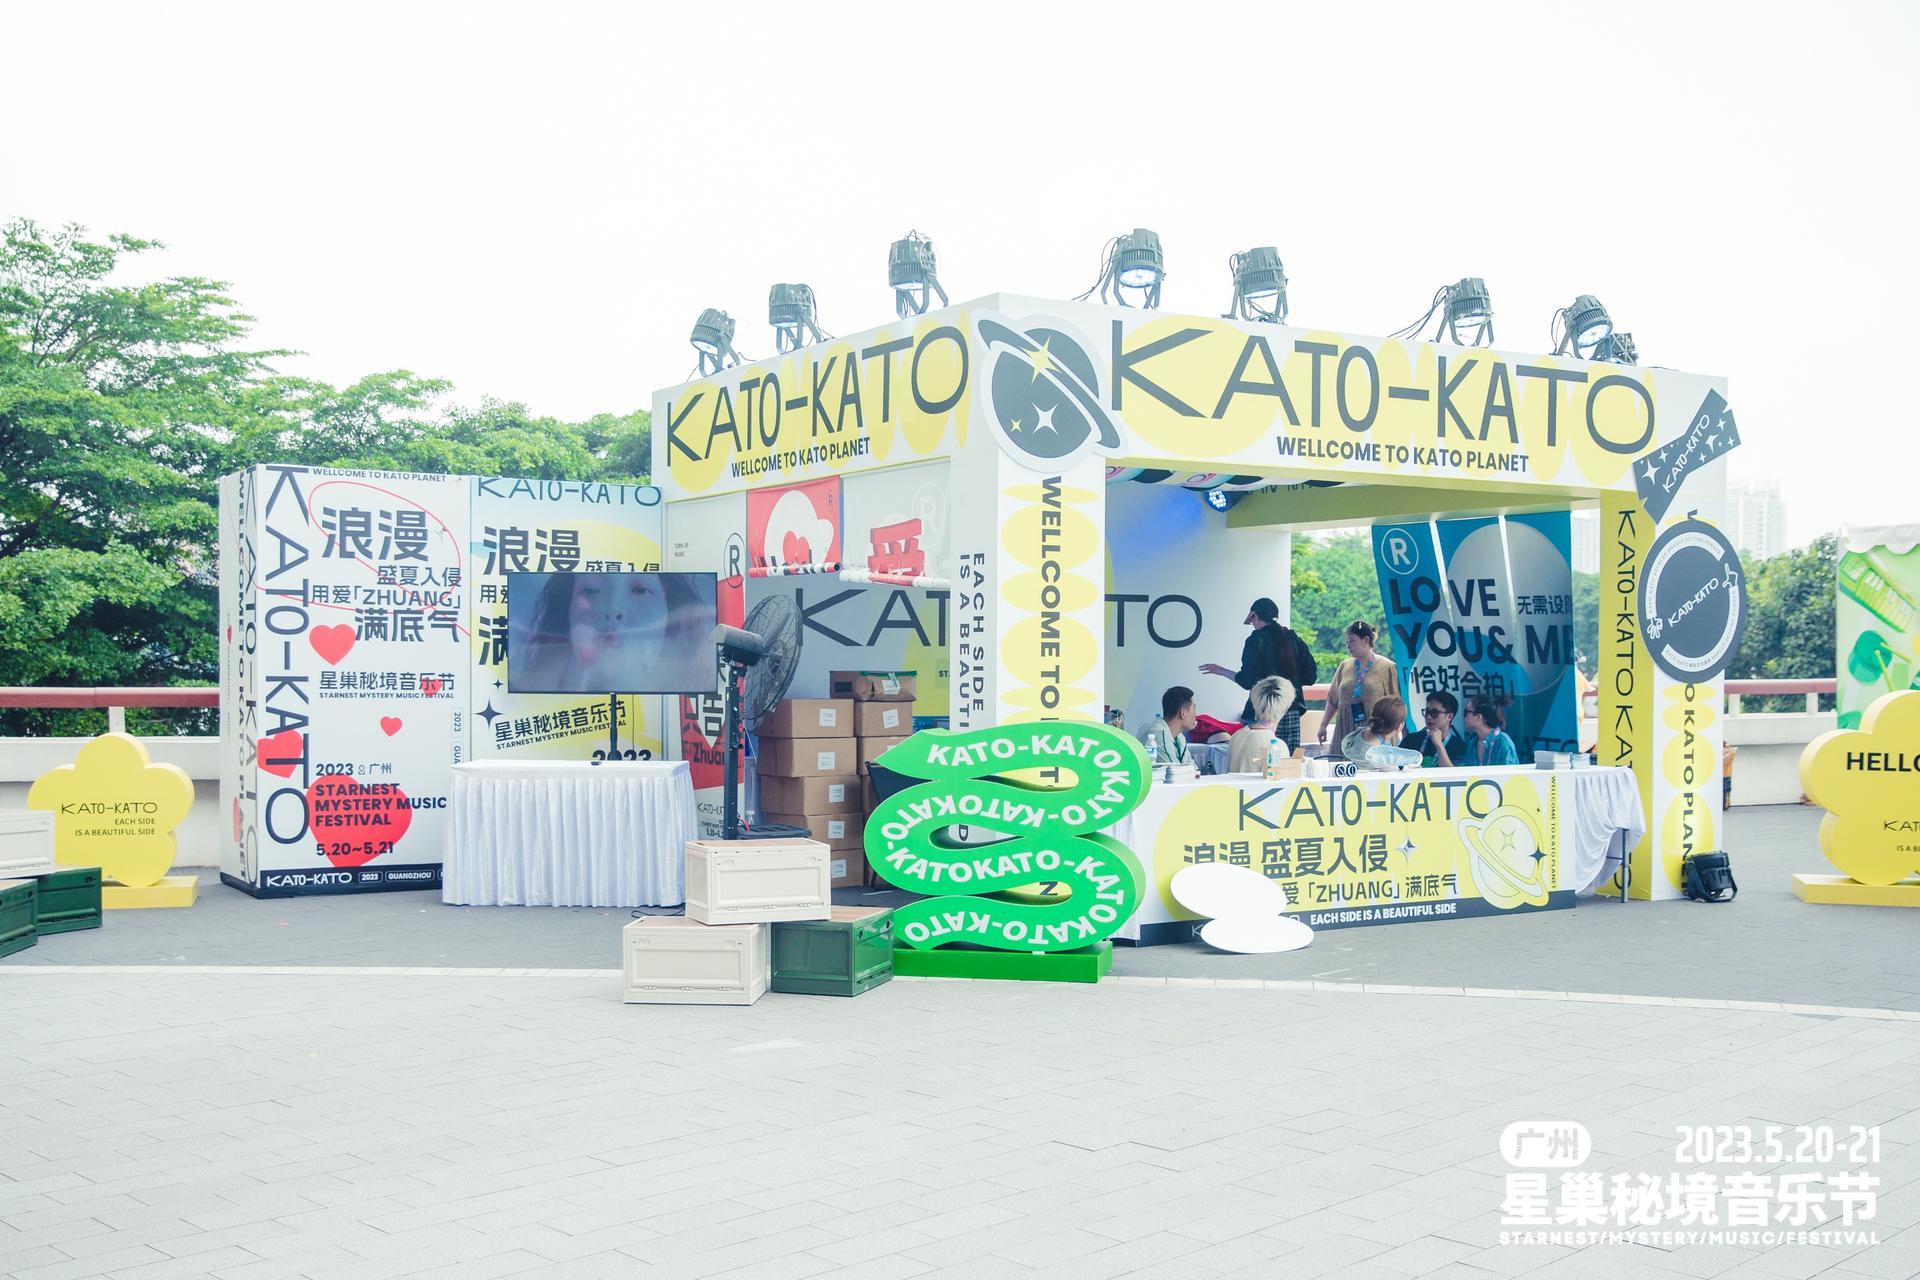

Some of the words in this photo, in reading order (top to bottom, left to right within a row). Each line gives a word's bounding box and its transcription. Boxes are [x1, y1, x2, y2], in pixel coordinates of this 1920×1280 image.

[667, 326, 969, 467] KATO-KATO
[1112, 320, 1655, 454] KATO-KATO
[732, 455, 782, 478] WELLCOME
[784, 451, 797, 467] TO
[799, 446, 827, 466] KATO
[830, 437, 871, 460] PLANET
[1276, 436, 1381, 462] WELLCOME
[1385, 444, 1409, 464] TO
[1413, 446, 1463, 468] KATO
[1466, 450, 1529, 473] PLANET
[1662, 414, 1711, 493] KATO-KATO
[313, 467, 367, 478] WELLCOME
[369, 470, 382, 479] TO
[384, 472, 410, 480] KATO
[412, 473, 447, 482] PLANET
[322, 507, 429, 562] 浪漫
[483, 526, 580, 576] 浪漫
[377, 565, 461, 587] 盛夏入侵
[960, 554, 971, 579] IS
[1040, 475, 1062, 657] WELLCOME
[960, 592, 970, 610] A
[973, 552, 985, 633] EACH
[1388, 576, 1500, 617] LOVE
[1615, 509, 1636, 696] KATO-KATO
[1668, 577, 1719, 627] KATO-KATO
[355, 607, 460, 643] 满底气
[265, 466, 310, 845] KATO-KATO
[319, 671, 455, 691] 星巢秘境音乐节
[973, 646, 984, 711] SIDE
[1040, 665, 1060, 709] TO
[453, 712, 461, 732] 2023
[496, 738, 534, 750] STARNEST
[535, 731, 569, 743] MYSTERY
[570, 726, 594, 736] MUSIC
[594, 719, 627, 733] FESTAL
[1683, 709, 1695, 785] KATO
[316, 763, 354, 776] 2023
[368, 763, 392, 776] 广州
[315, 783, 400, 796] STARNEST
[315, 798, 392, 812] MYSTERY
[396, 796, 447, 810] MUSIC
[1239, 779, 1504, 831] KATO-KATO
[61, 801, 158, 815] KATO-KATO
[315, 814, 391, 827] FESTIVAL
[1883, 820, 1920, 832] KAT
[1261, 834, 1389, 880] 盛夏入侵
[267, 872, 352, 887] KATO-KATO
[361, 873, 379, 881] 2023
[388, 872, 432, 880] GUANGZHOU
[1310, 912, 1339, 926] EACH
[1340, 911, 1362, 923] SIDE
[1363, 910, 1372, 920] IS
[1374, 909, 1382, 920] A
[1382, 904, 1434, 919] BEAUTIFUL
[1435, 903, 1457, 915] SIDE
